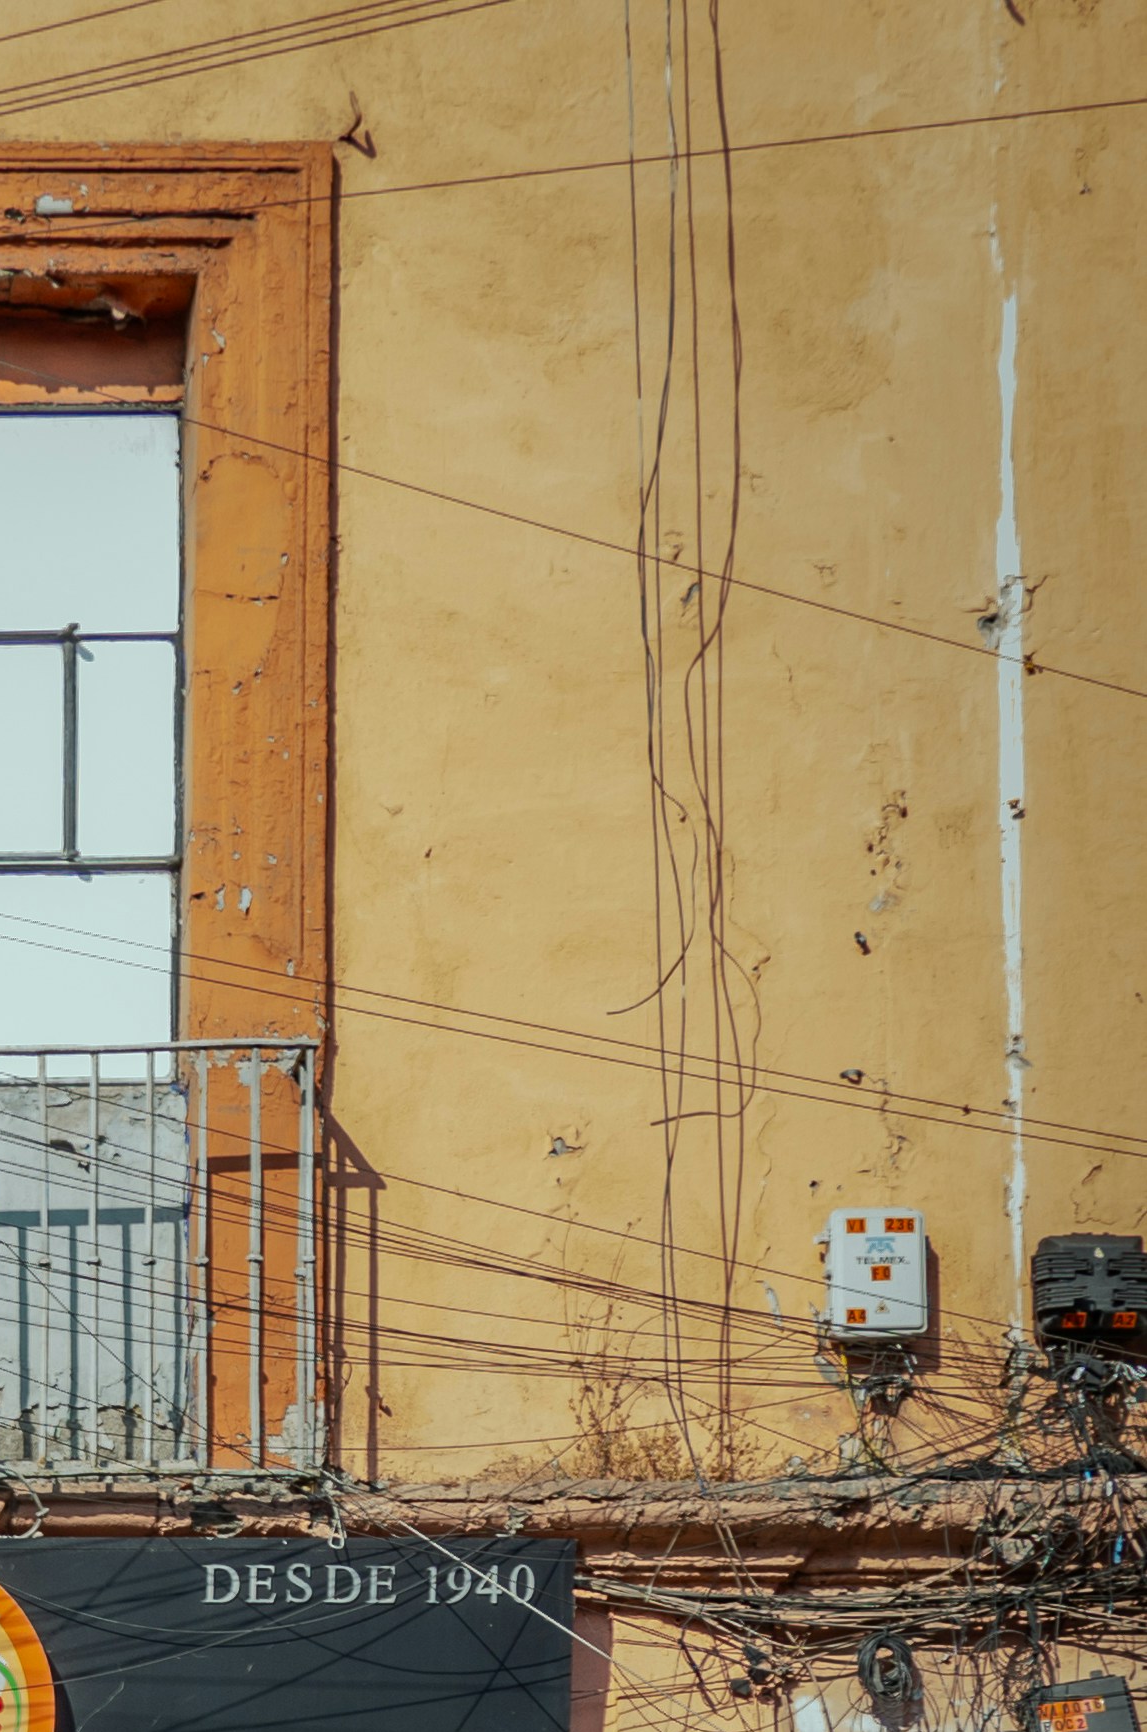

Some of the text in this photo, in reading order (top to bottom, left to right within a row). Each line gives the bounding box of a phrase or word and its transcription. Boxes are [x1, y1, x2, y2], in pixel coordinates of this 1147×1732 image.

[885, 1218, 914, 1230] 236
[201, 1562, 536, 1605] DESDE 1940
